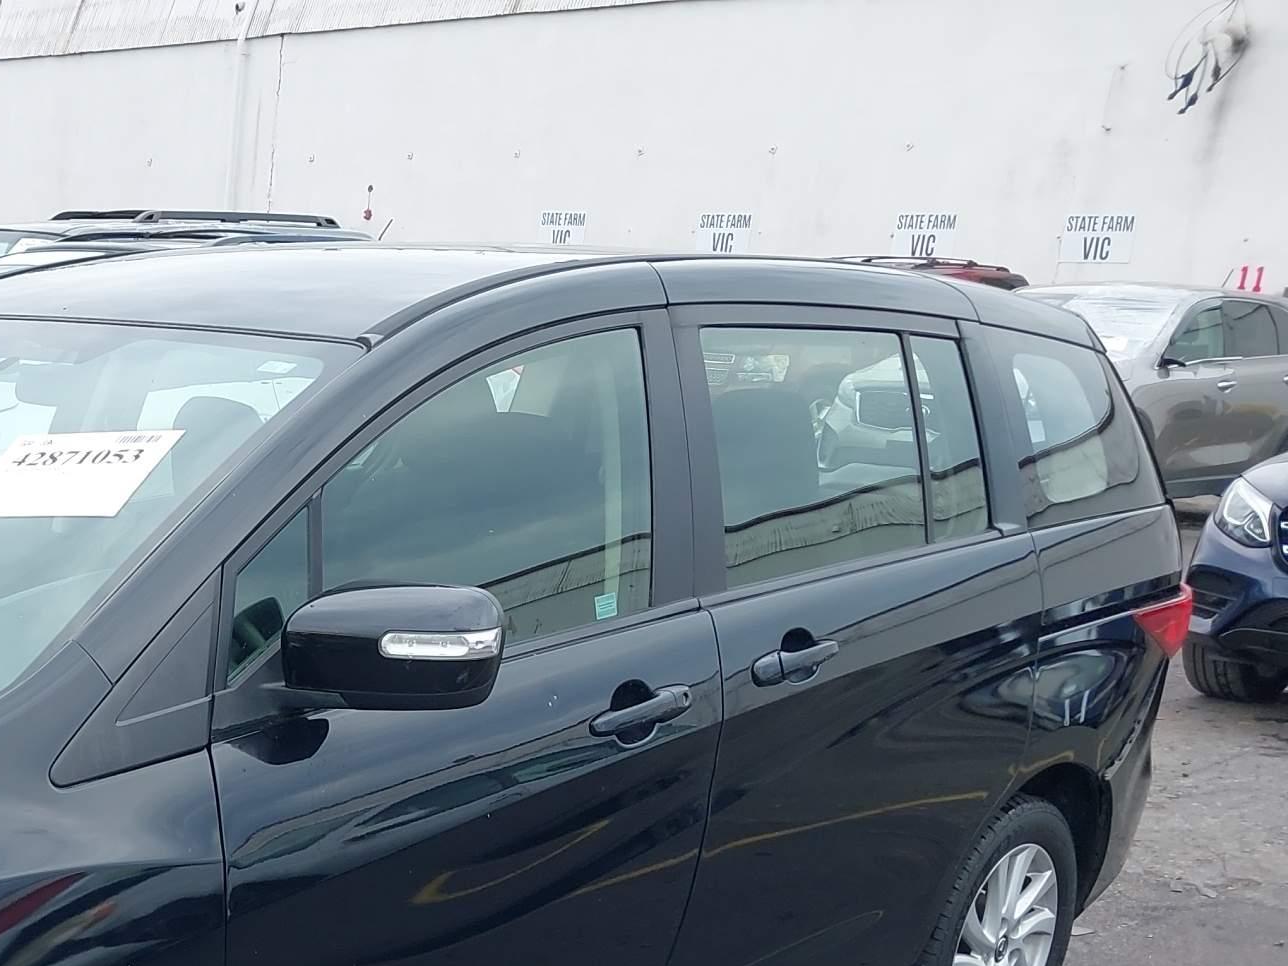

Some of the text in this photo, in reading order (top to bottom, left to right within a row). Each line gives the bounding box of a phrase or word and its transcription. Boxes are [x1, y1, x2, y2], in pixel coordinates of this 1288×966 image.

[541, 212, 586, 227] STATE FARM
[700, 214, 752, 229] STATE FARM
[897, 214, 957, 230] STATE FARM
[1067, 216, 1135, 233] STATE FARM
[712, 232, 734, 253] VIC
[911, 234, 936, 257] VIC
[1083, 237, 1111, 261] VIC
[1237, 266, 1264, 292] 11
[12, 449, 144, 466] 42871053
